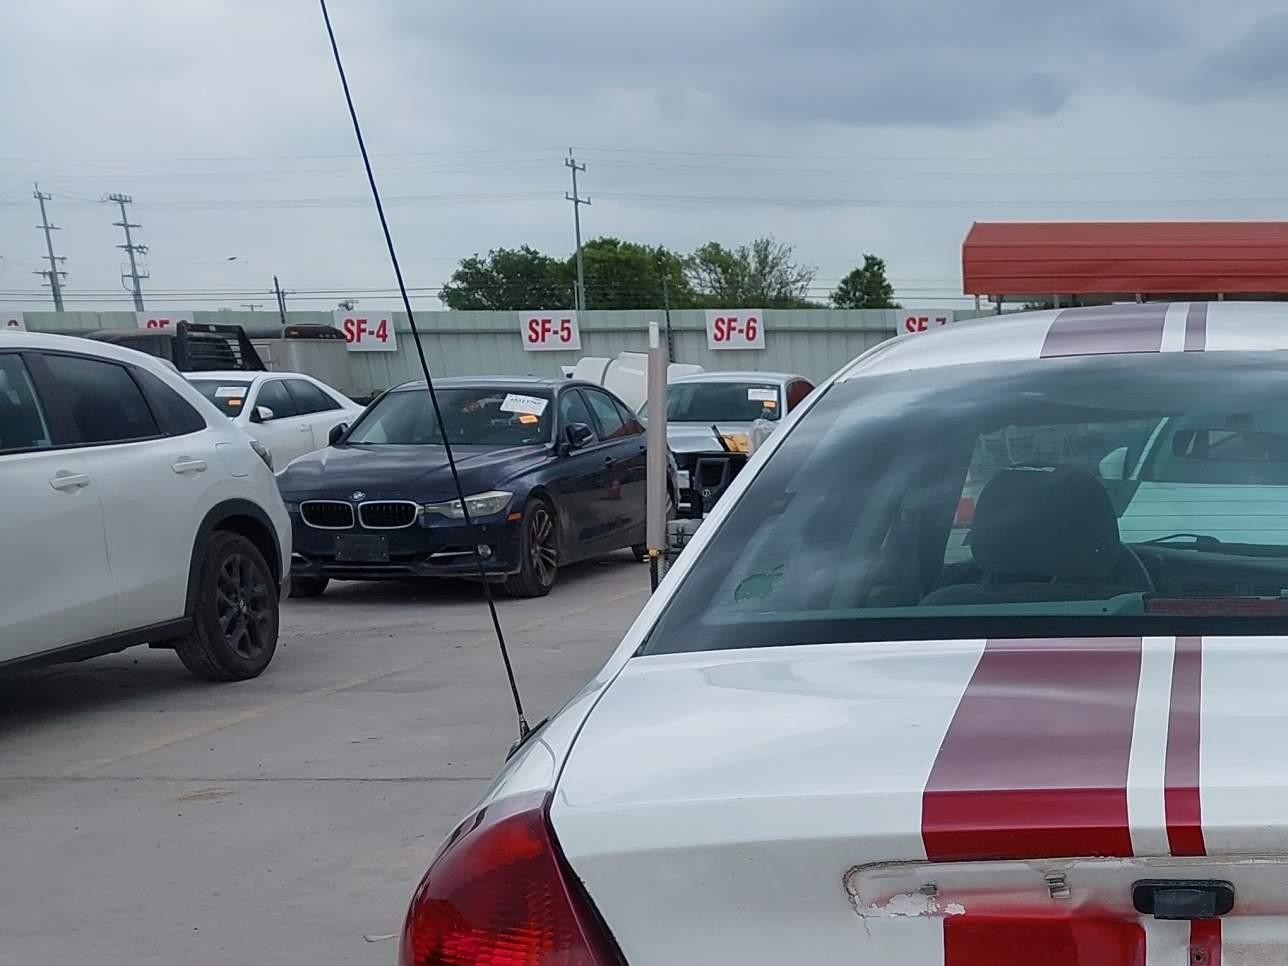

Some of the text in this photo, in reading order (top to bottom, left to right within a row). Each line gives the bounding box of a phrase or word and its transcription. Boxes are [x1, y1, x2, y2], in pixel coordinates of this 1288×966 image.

[343, 318, 388, 343] SF-4
[528, 318, 572, 343] SF-5
[713, 317, 758, 342] SF-6
